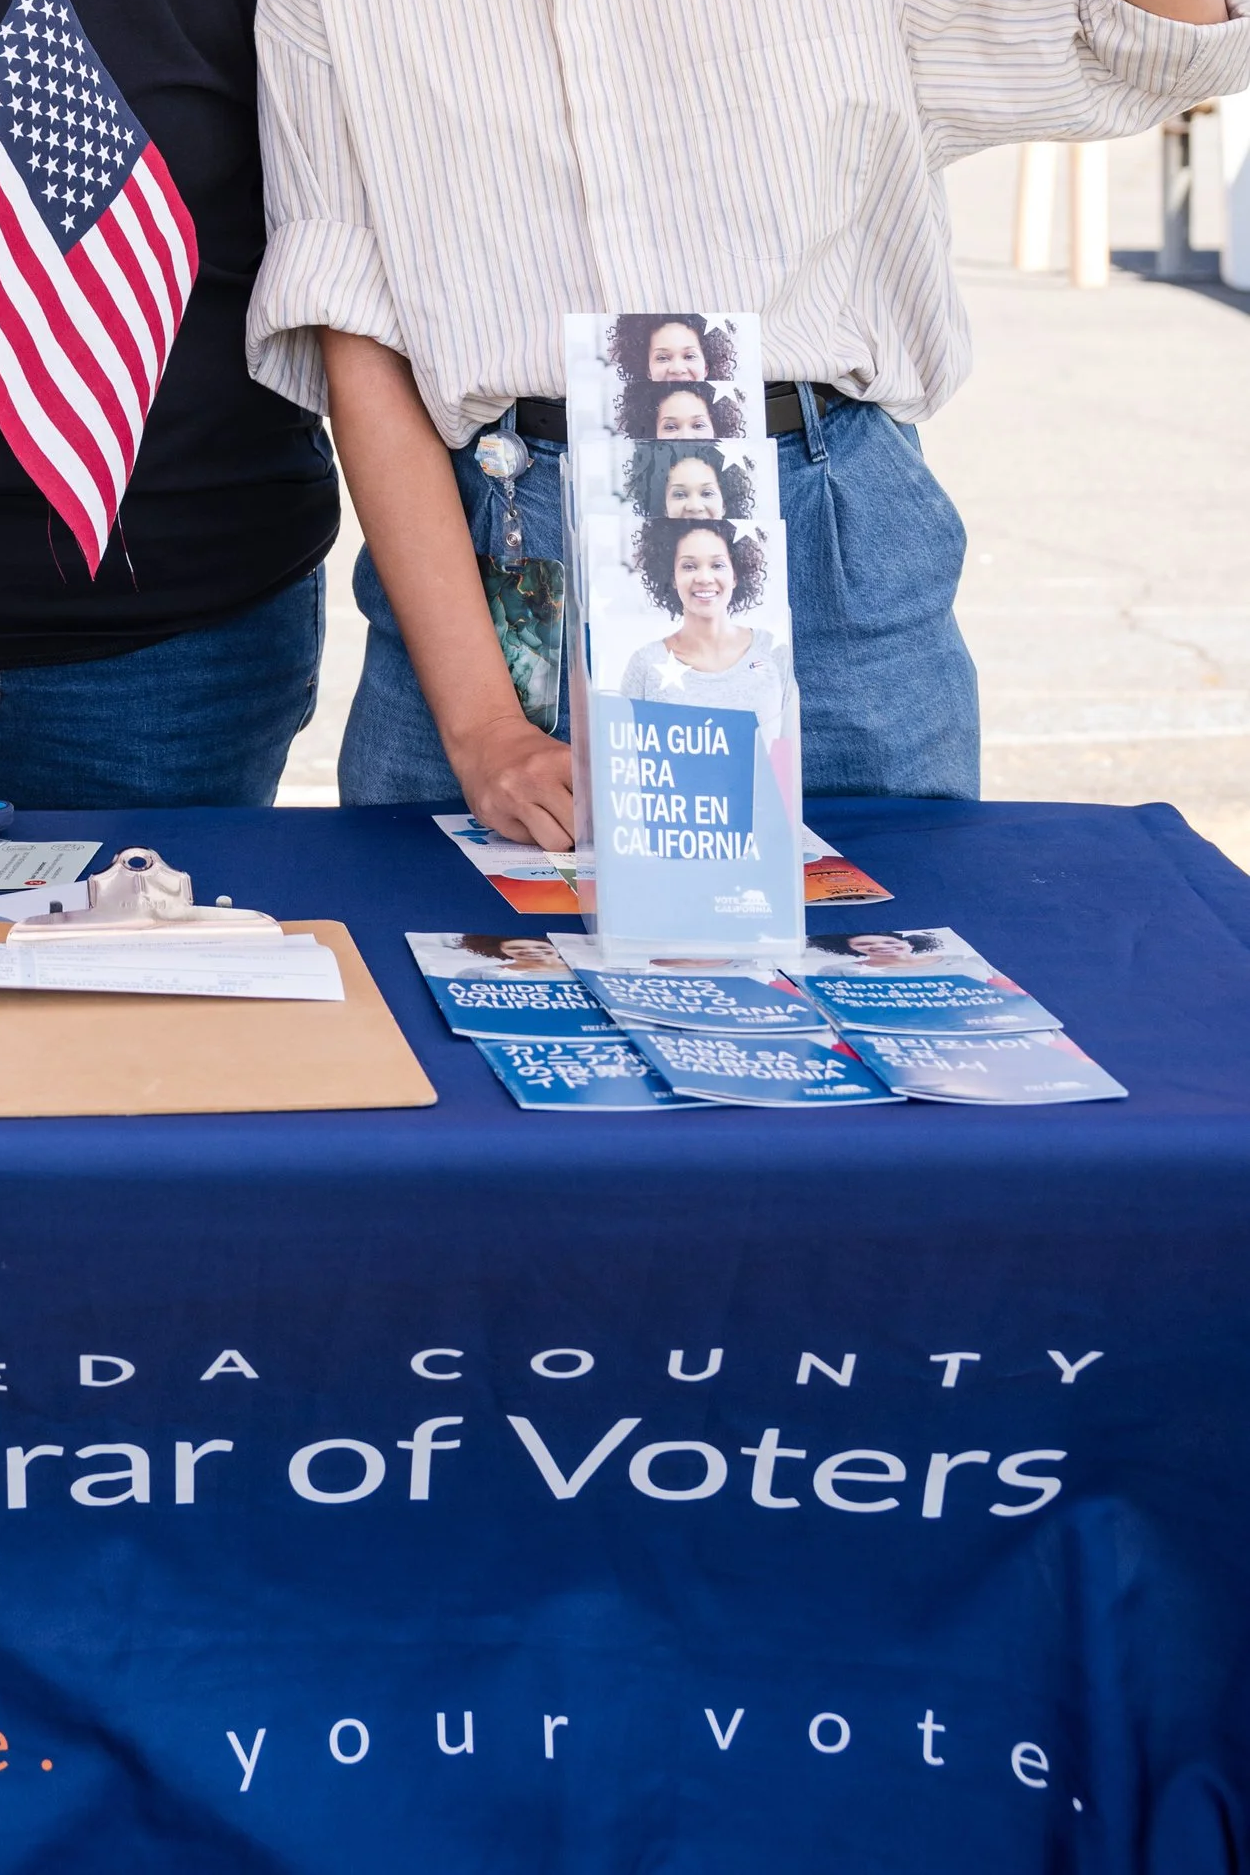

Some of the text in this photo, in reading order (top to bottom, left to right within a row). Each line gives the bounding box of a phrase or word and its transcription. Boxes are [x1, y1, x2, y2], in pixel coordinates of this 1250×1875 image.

[609, 717, 729, 755] UNA GUÍA
[610, 756, 675, 788] PARA
[610, 790, 729, 825] VOTAR EN
[613, 826, 761, 861] CALIFORNIA
[714, 896, 741, 905] VOTE
[714, 904, 772, 914] CALIFORNIA
[447, 982, 589, 994] A GUIDE TO
[449, 990, 585, 1001] VOTING IN
[454, 998, 603, 1010] CALIFORNI
[615, 996, 809, 1016] CALIFORNIA
[647, 1034, 738, 1050] ISANG
[655, 1043, 798, 1062] GABAY SA
[669, 1061, 846, 1081] CALIFORNIA
[804, 1059, 847, 1071] SA
[410, 1348, 1104, 1388] COUNTY
[288, 1416, 464, 1504] of
[506, 1414, 1068, 1518] Voters
[226, 1711, 568, 1792] your
[703, 1706, 1083, 1812] vote.
